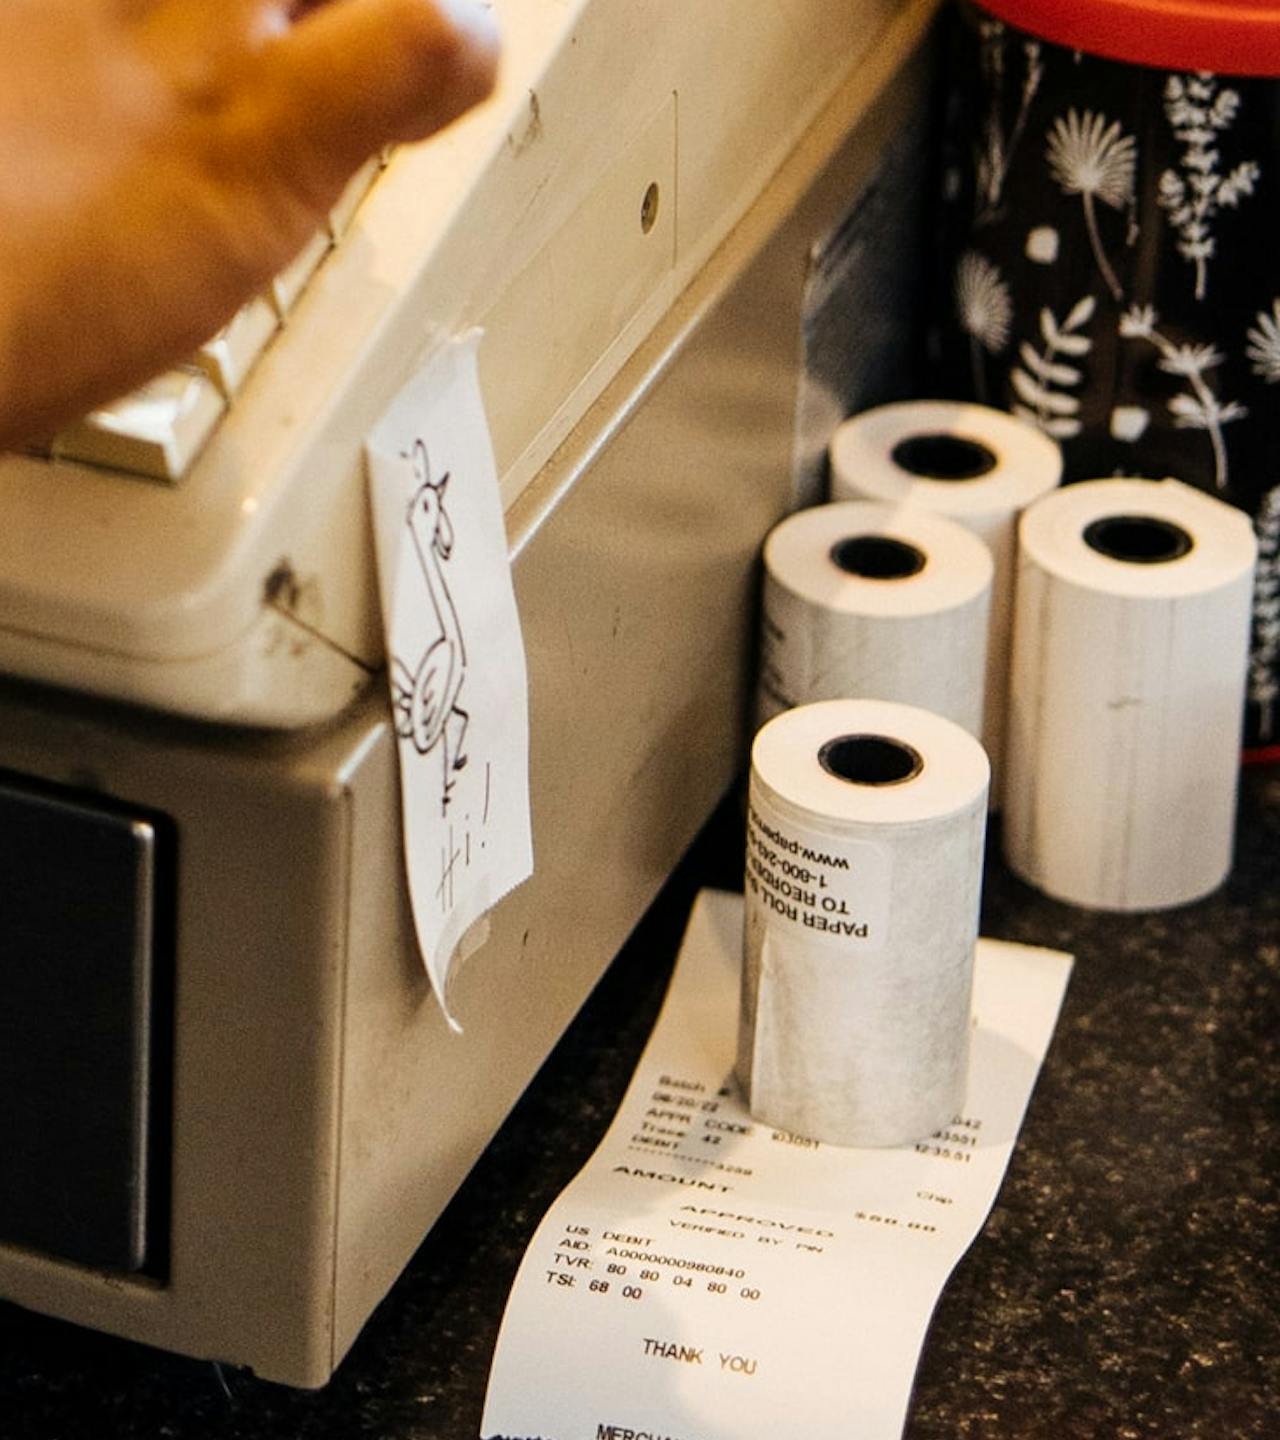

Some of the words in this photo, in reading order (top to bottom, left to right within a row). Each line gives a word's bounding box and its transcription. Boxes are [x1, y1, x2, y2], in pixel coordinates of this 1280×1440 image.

[436, 760, 492, 914] Hi!
[760, 886, 798, 921] ROLL
[821, 897, 850, 916] TO
[802, 911, 870, 939] PAPER
[659, 1075, 706, 1095] Batch
[640, 1122, 688, 1140] Trace
[645, 1107, 692, 1126] APPR
[704, 1118, 752, 1136] CODE
[630, 1133, 679, 1151] DEBIT
[612, 1165, 736, 1195] AMOUNT
[668, 1219, 747, 1240] VERIFIED
[756, 1235, 784, 1247] BY
[679, 1204, 836, 1239] APPROVED
[558, 1238, 592, 1252] AID:
[565, 1224, 590, 1238] US
[602, 1231, 657, 1248] DEBIT
[552, 1252, 594, 1270] TVR:
[606, 1262, 628, 1277] 80
[639, 1269, 661, 1283] 80
[672, 1275, 694, 1289] 04
[706, 1281, 728, 1295] 80
[739, 1286, 762, 1301] 00
[588, 1278, 610, 1294] 68
[621, 1285, 644, 1301] 00
[643, 1337, 704, 1366] THANK
[718, 1351, 758, 1376] YOU
